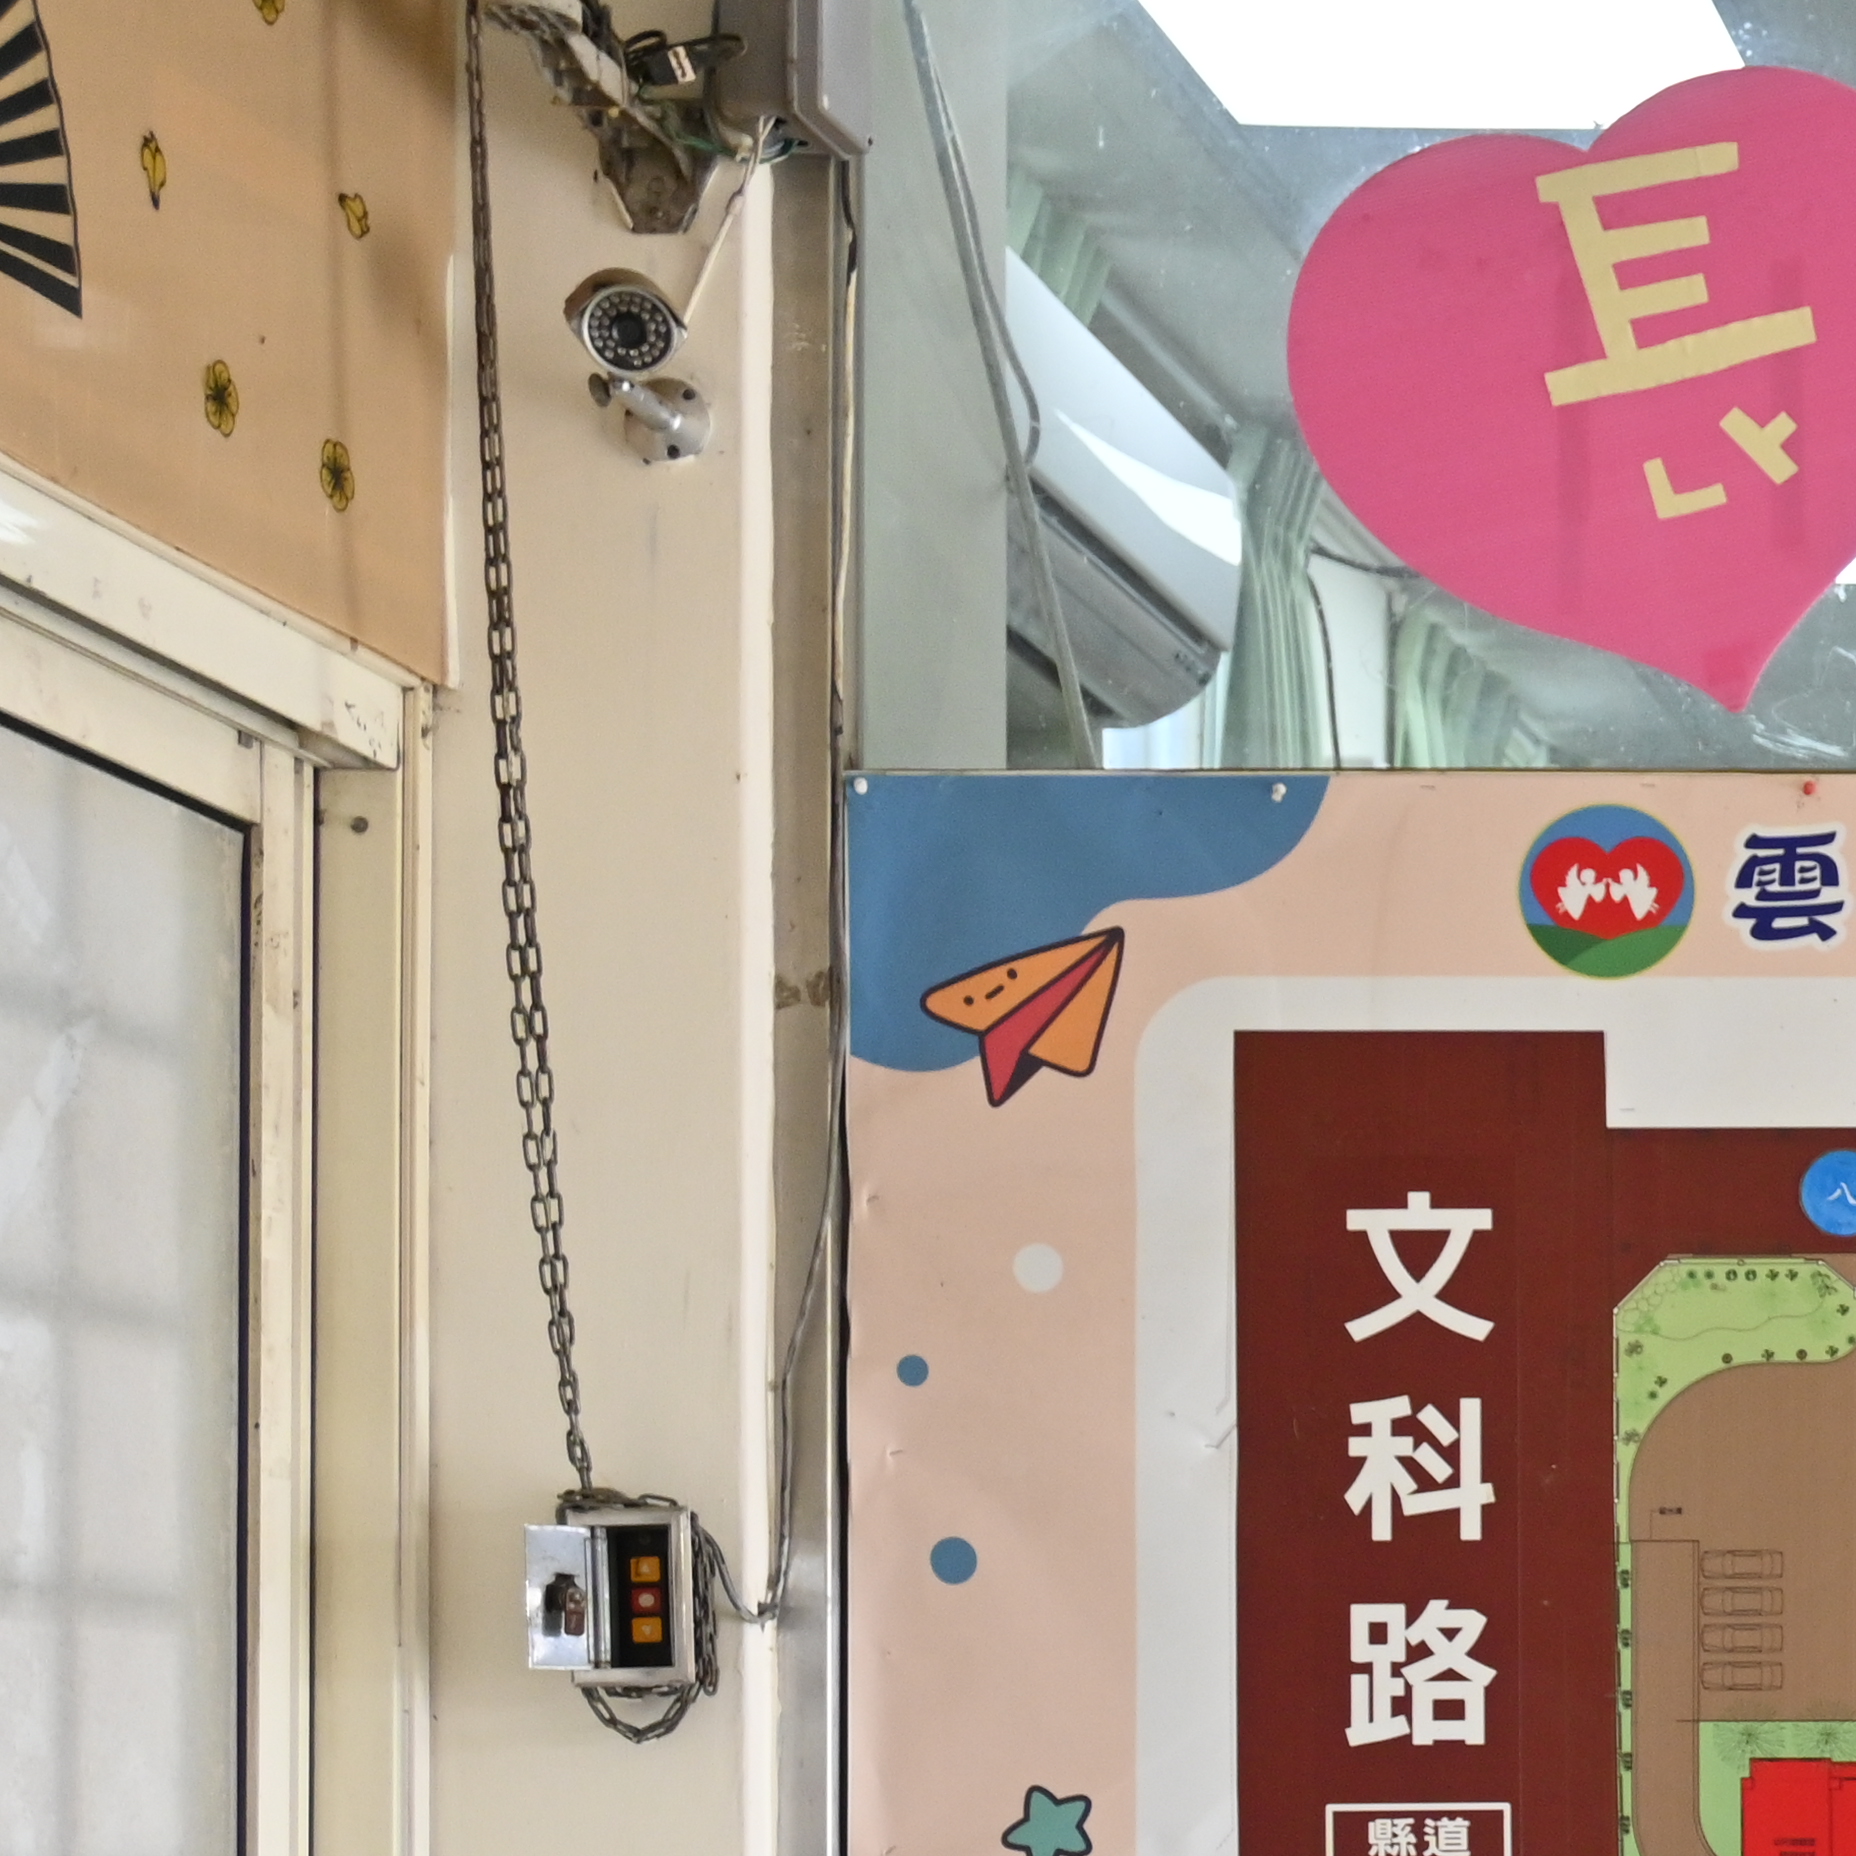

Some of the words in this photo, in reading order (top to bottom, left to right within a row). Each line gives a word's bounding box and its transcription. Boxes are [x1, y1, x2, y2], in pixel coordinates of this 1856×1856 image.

[1536, 140, 1816, 520] 長
[1344, 1190, 1497, 1747] 文科路
